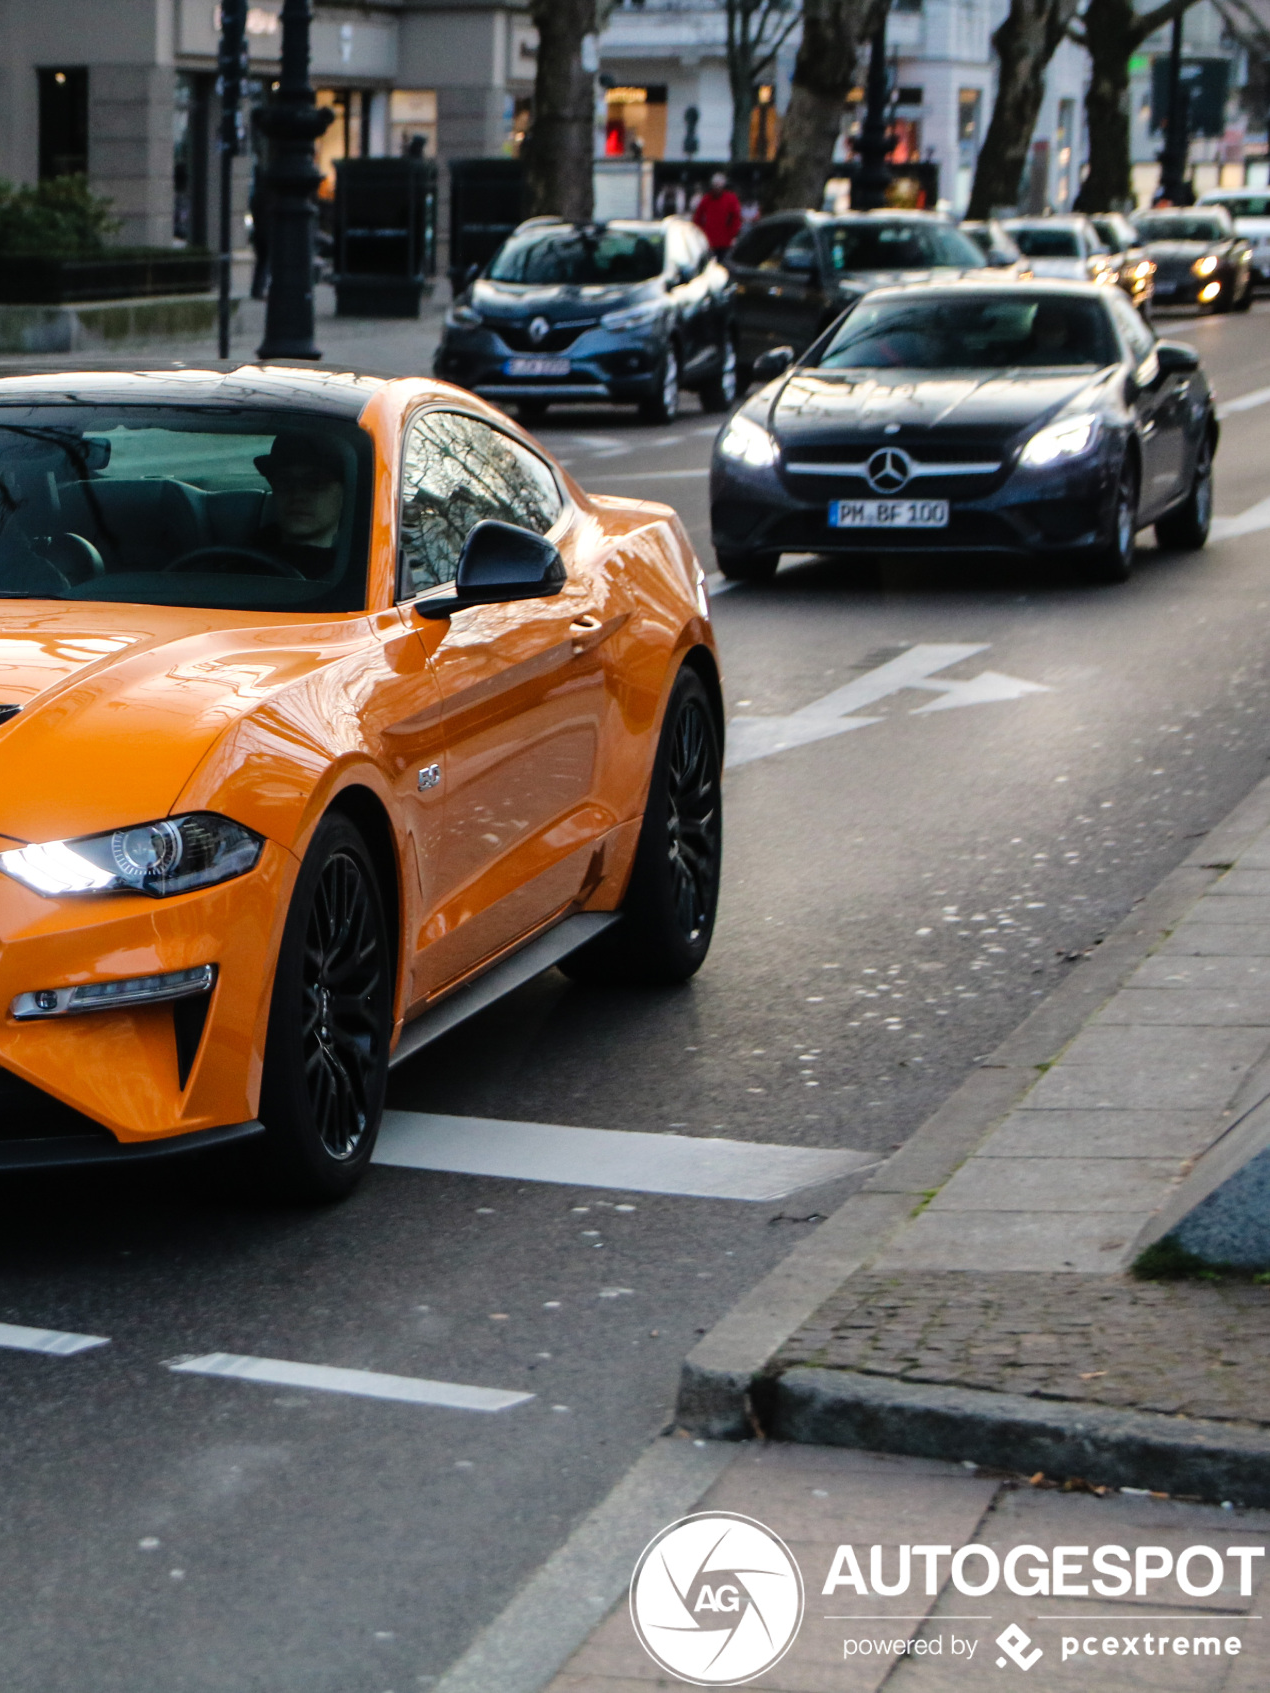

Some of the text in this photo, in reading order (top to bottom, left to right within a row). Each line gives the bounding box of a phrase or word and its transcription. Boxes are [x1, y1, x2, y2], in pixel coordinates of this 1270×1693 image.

[841, 503, 946, 523] PM BF 100
